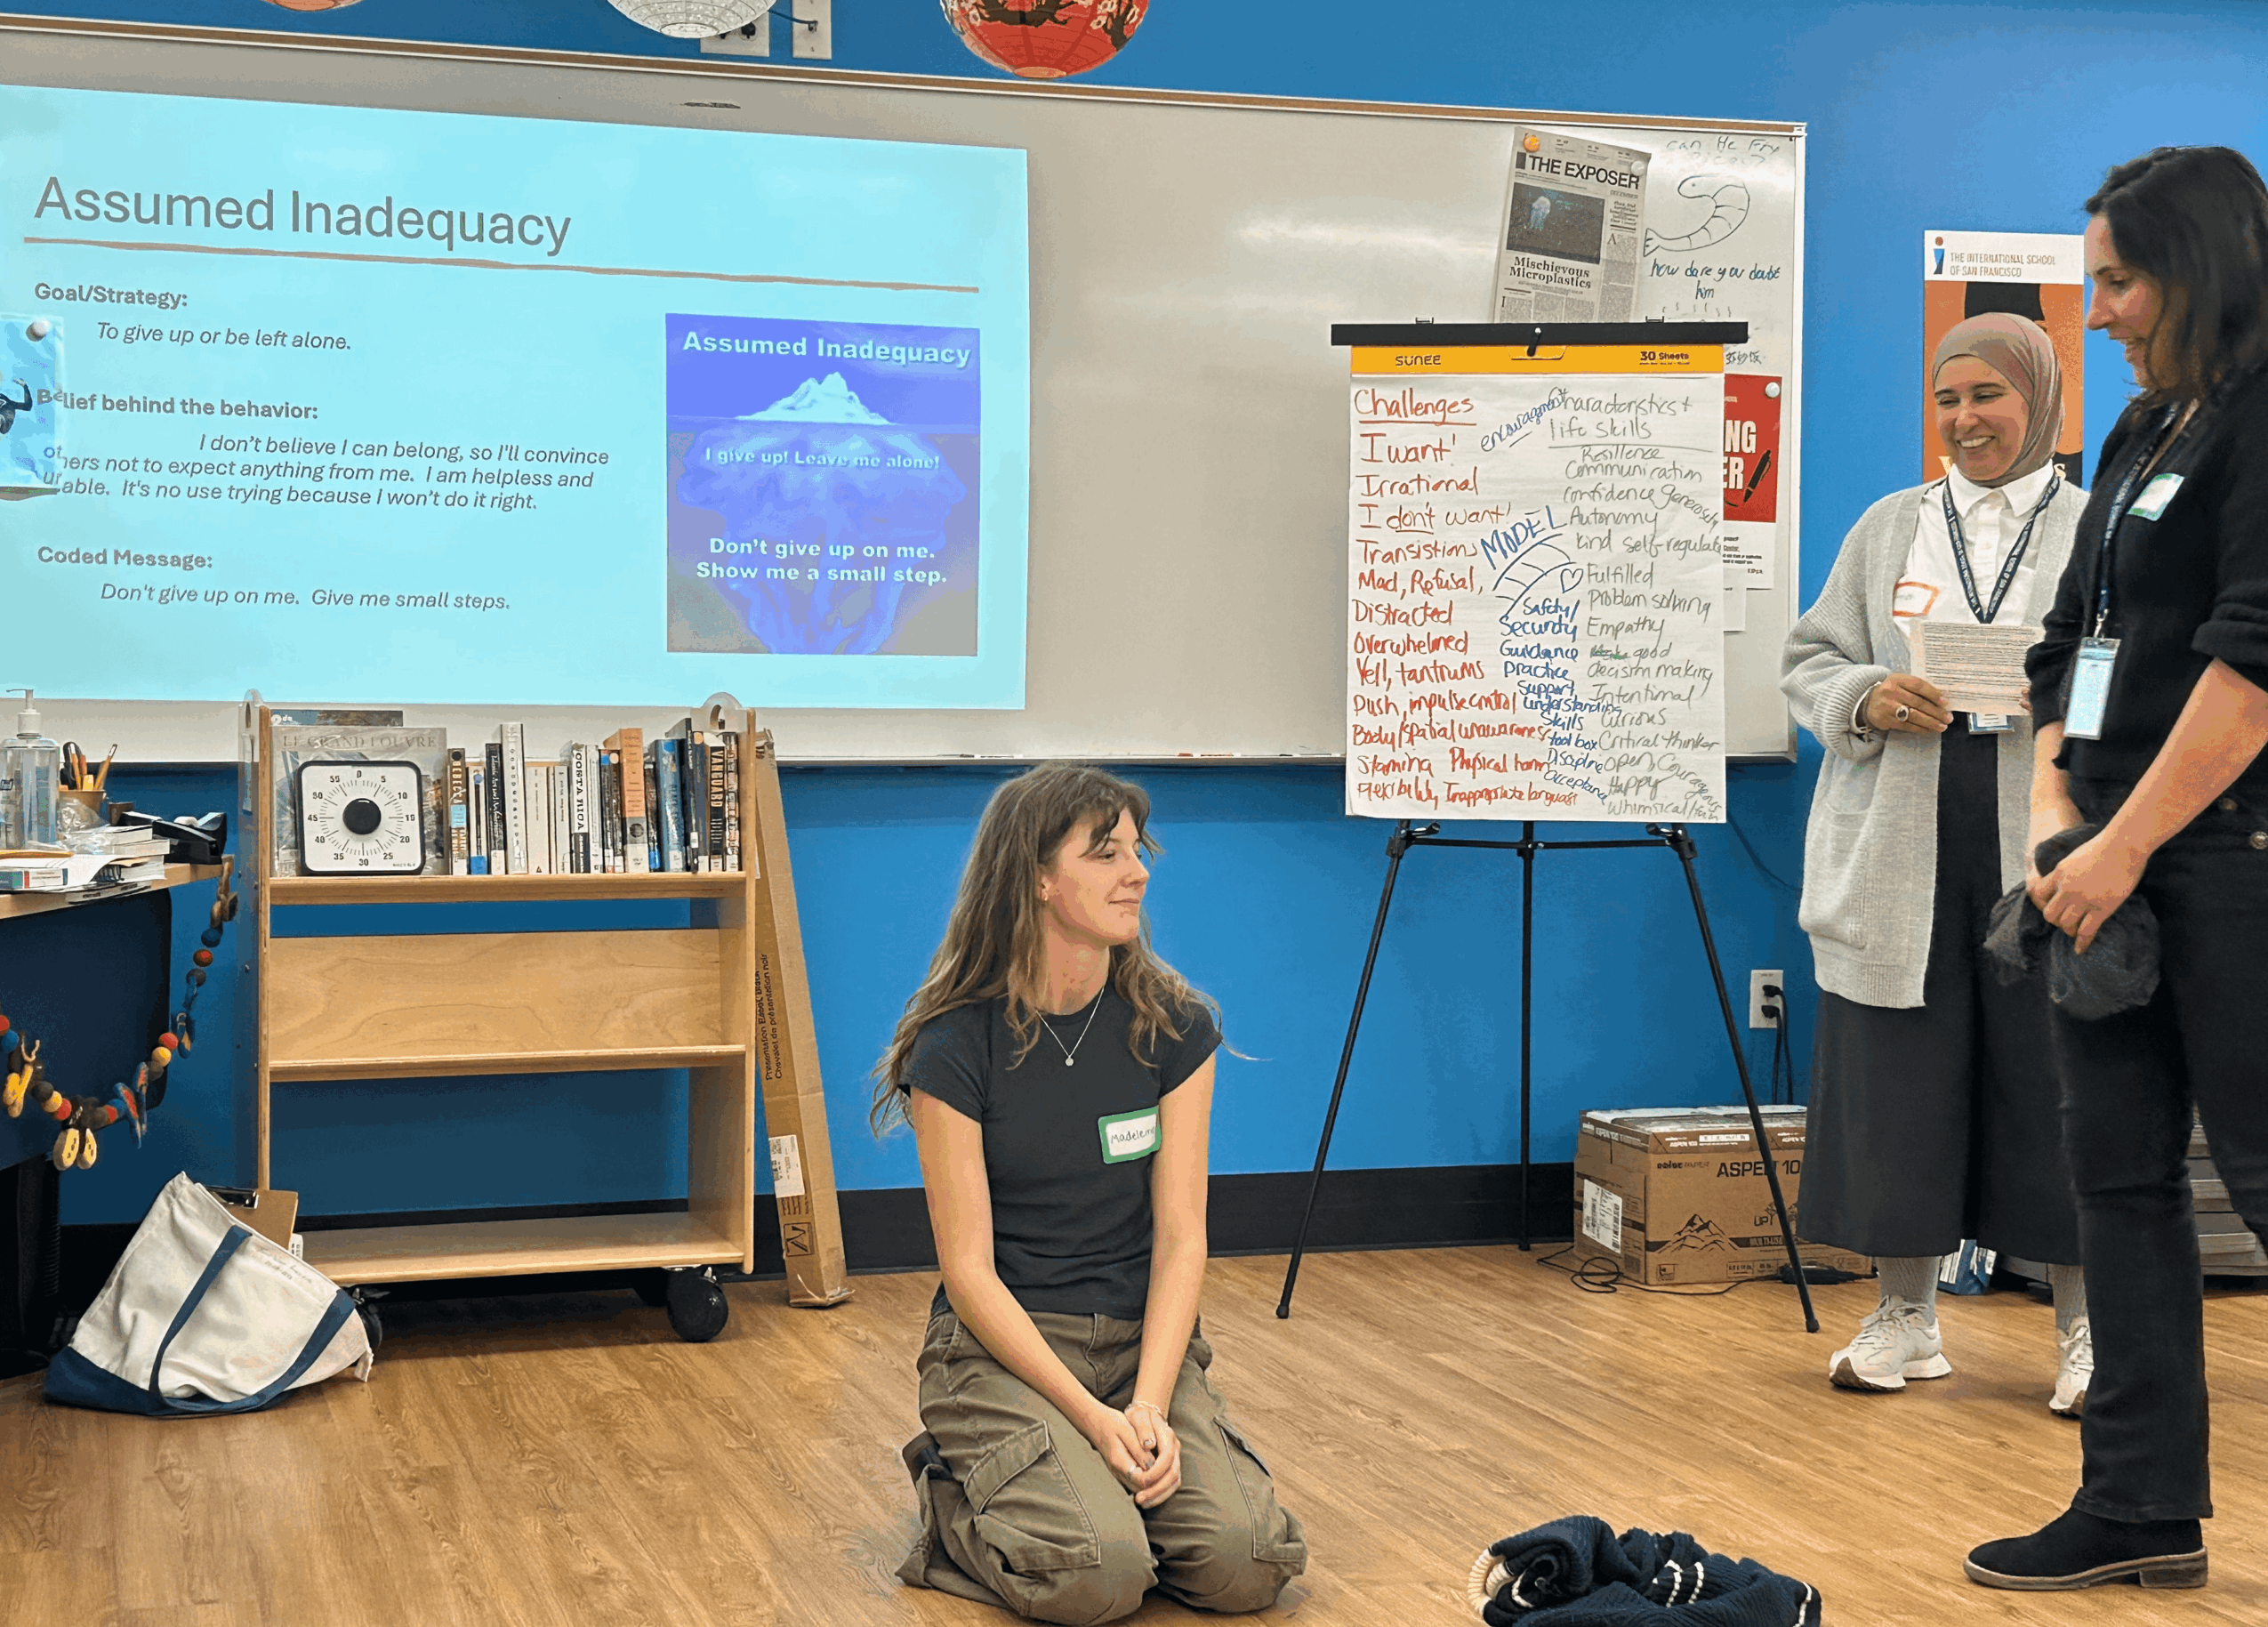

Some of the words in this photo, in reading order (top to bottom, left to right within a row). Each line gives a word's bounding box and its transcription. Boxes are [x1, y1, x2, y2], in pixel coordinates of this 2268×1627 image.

[1528, 155, 1562, 174] THE
[1564, 161, 1640, 190] EXPOSER
[34, 176, 274, 231] Assumed
[292, 189, 571, 256] Inadequacy
[1514, 255, 1590, 278] Mischievous
[1650, 257, 1680, 278] how
[1685, 260, 1713, 278] dare
[1950, 252, 1965, 263] THE
[1966, 253, 2025, 265] INTERNATIONAL
[2026, 254, 2056, 266] SCHOOL
[1950, 265, 1961, 276] OF
[1962, 266, 1978, 277] SAN
[1979, 266, 2023, 278] FRANCISCO
[1509, 265, 1592, 290] Microplastics
[1695, 279, 1715, 301] him
[34, 282, 189, 310] Goal/Strategy:
[97, 321, 119, 340] To
[123, 323, 164, 344] give
[169, 328, 194, 347] up
[199, 330, 221, 345] or
[225, 327, 250, 346] be
[255, 328, 287, 348] left
[292, 329, 351, 351] alone.
[682, 331, 808, 358] Assumed
[817, 337, 971, 369] Inadequacy
[1639, 350, 1657, 362] 30
[1659, 351, 1691, 362] Sheets
[36, 389, 97, 412] Belief
[101, 394, 175, 415] behind
[180, 397, 215, 416] the
[220, 399, 318, 420] behavior:
[1355, 387, 1475, 425] Challenges
[1550, 415, 1588, 441] life
[198, 433, 206, 452] I
[210, 434, 261, 454] don’t
[265, 437, 336, 455] believe
[341, 439, 349, 456] I
[351, 443, 388, 458] can
[392, 440, 464, 463] belong,
[469, 446, 494, 462] so
[496, 444, 519, 463] I'll
[524, 447, 610, 465] convince
[705, 447, 712, 462] I
[717, 447, 756, 466] give
[760, 449, 789, 467] up!
[794, 450, 847, 468] Leave
[853, 455, 881, 469] me
[886, 454, 940, 471] alone!
[1359, 432, 1387, 463] I
[104, 455, 139, 473] not
[142, 456, 163, 474] to
[167, 459, 237, 479] expect
[239, 462, 326, 483] anything
[328, 463, 375, 481] from
[379, 467, 415, 483] me.
[426, 465, 432, 483] I
[436, 470, 468, 485] am
[471, 467, 554, 489] helpless
[557, 471, 595, 488] and
[1355, 465, 1479, 498] Irrational
[1564, 459, 1703, 483] Communication
[122, 479, 151, 497] It's
[155, 483, 181, 499] no
[187, 484, 223, 500] use
[227, 484, 282, 505] trying
[286, 487, 373, 505] because
[376, 487, 383, 505] I
[387, 489, 440, 507] won’t
[444, 490, 470, 508] do
[472, 490, 487, 509] it
[489, 493, 538, 513] right.
[1357, 503, 1382, 529] I
[1385, 501, 1436, 531] don't
[1569, 504, 1660, 536] Autonomy
[709, 537, 768, 557] Don’t
[775, 540, 822, 560] give
[828, 544, 855, 560] up
[862, 544, 889, 559] on
[896, 544, 936, 560] me.
[1479, 503, 1568, 571] MODEL
[37, 545, 109, 566] Coded
[113, 549, 213, 572] Message:
[696, 561, 759, 581] Show
[766, 565, 800, 581] me
[807, 567, 820, 581] a
[826, 563, 887, 583] small
[892, 565, 948, 587] step.
[1358, 568, 1408, 601] Mad,
[1586, 561, 1655, 590] Fulfilled
[101, 583, 156, 601] Don't
[157, 584, 198, 607] give
[203, 589, 229, 608] up
[233, 589, 259, 605] on
[263, 590, 301, 606] me.
[310, 589, 355, 607] Give
[358, 592, 390, 608] me
[395, 592, 450, 609] small
[453, 593, 511, 613] steps.
[1587, 587, 1648, 613] Problem
[1352, 598, 1454, 627] Distracted
[1499, 613, 1579, 644] Security
[1586, 615, 1666, 648] Empathy
[1499, 639, 1580, 664] Guidance
[1632, 641, 1673, 667] good
[381, 775, 386, 783] 5
[711, 750, 724, 809] VANGUARD
[398, 792, 407, 800] 10
[307, 814, 318, 822] 45
[315, 835, 326, 843] 40
[399, 835, 410, 843] 20
[334, 852, 344, 860] 35
[358, 858, 369, 866] 30
[382, 852, 394, 860] 25
